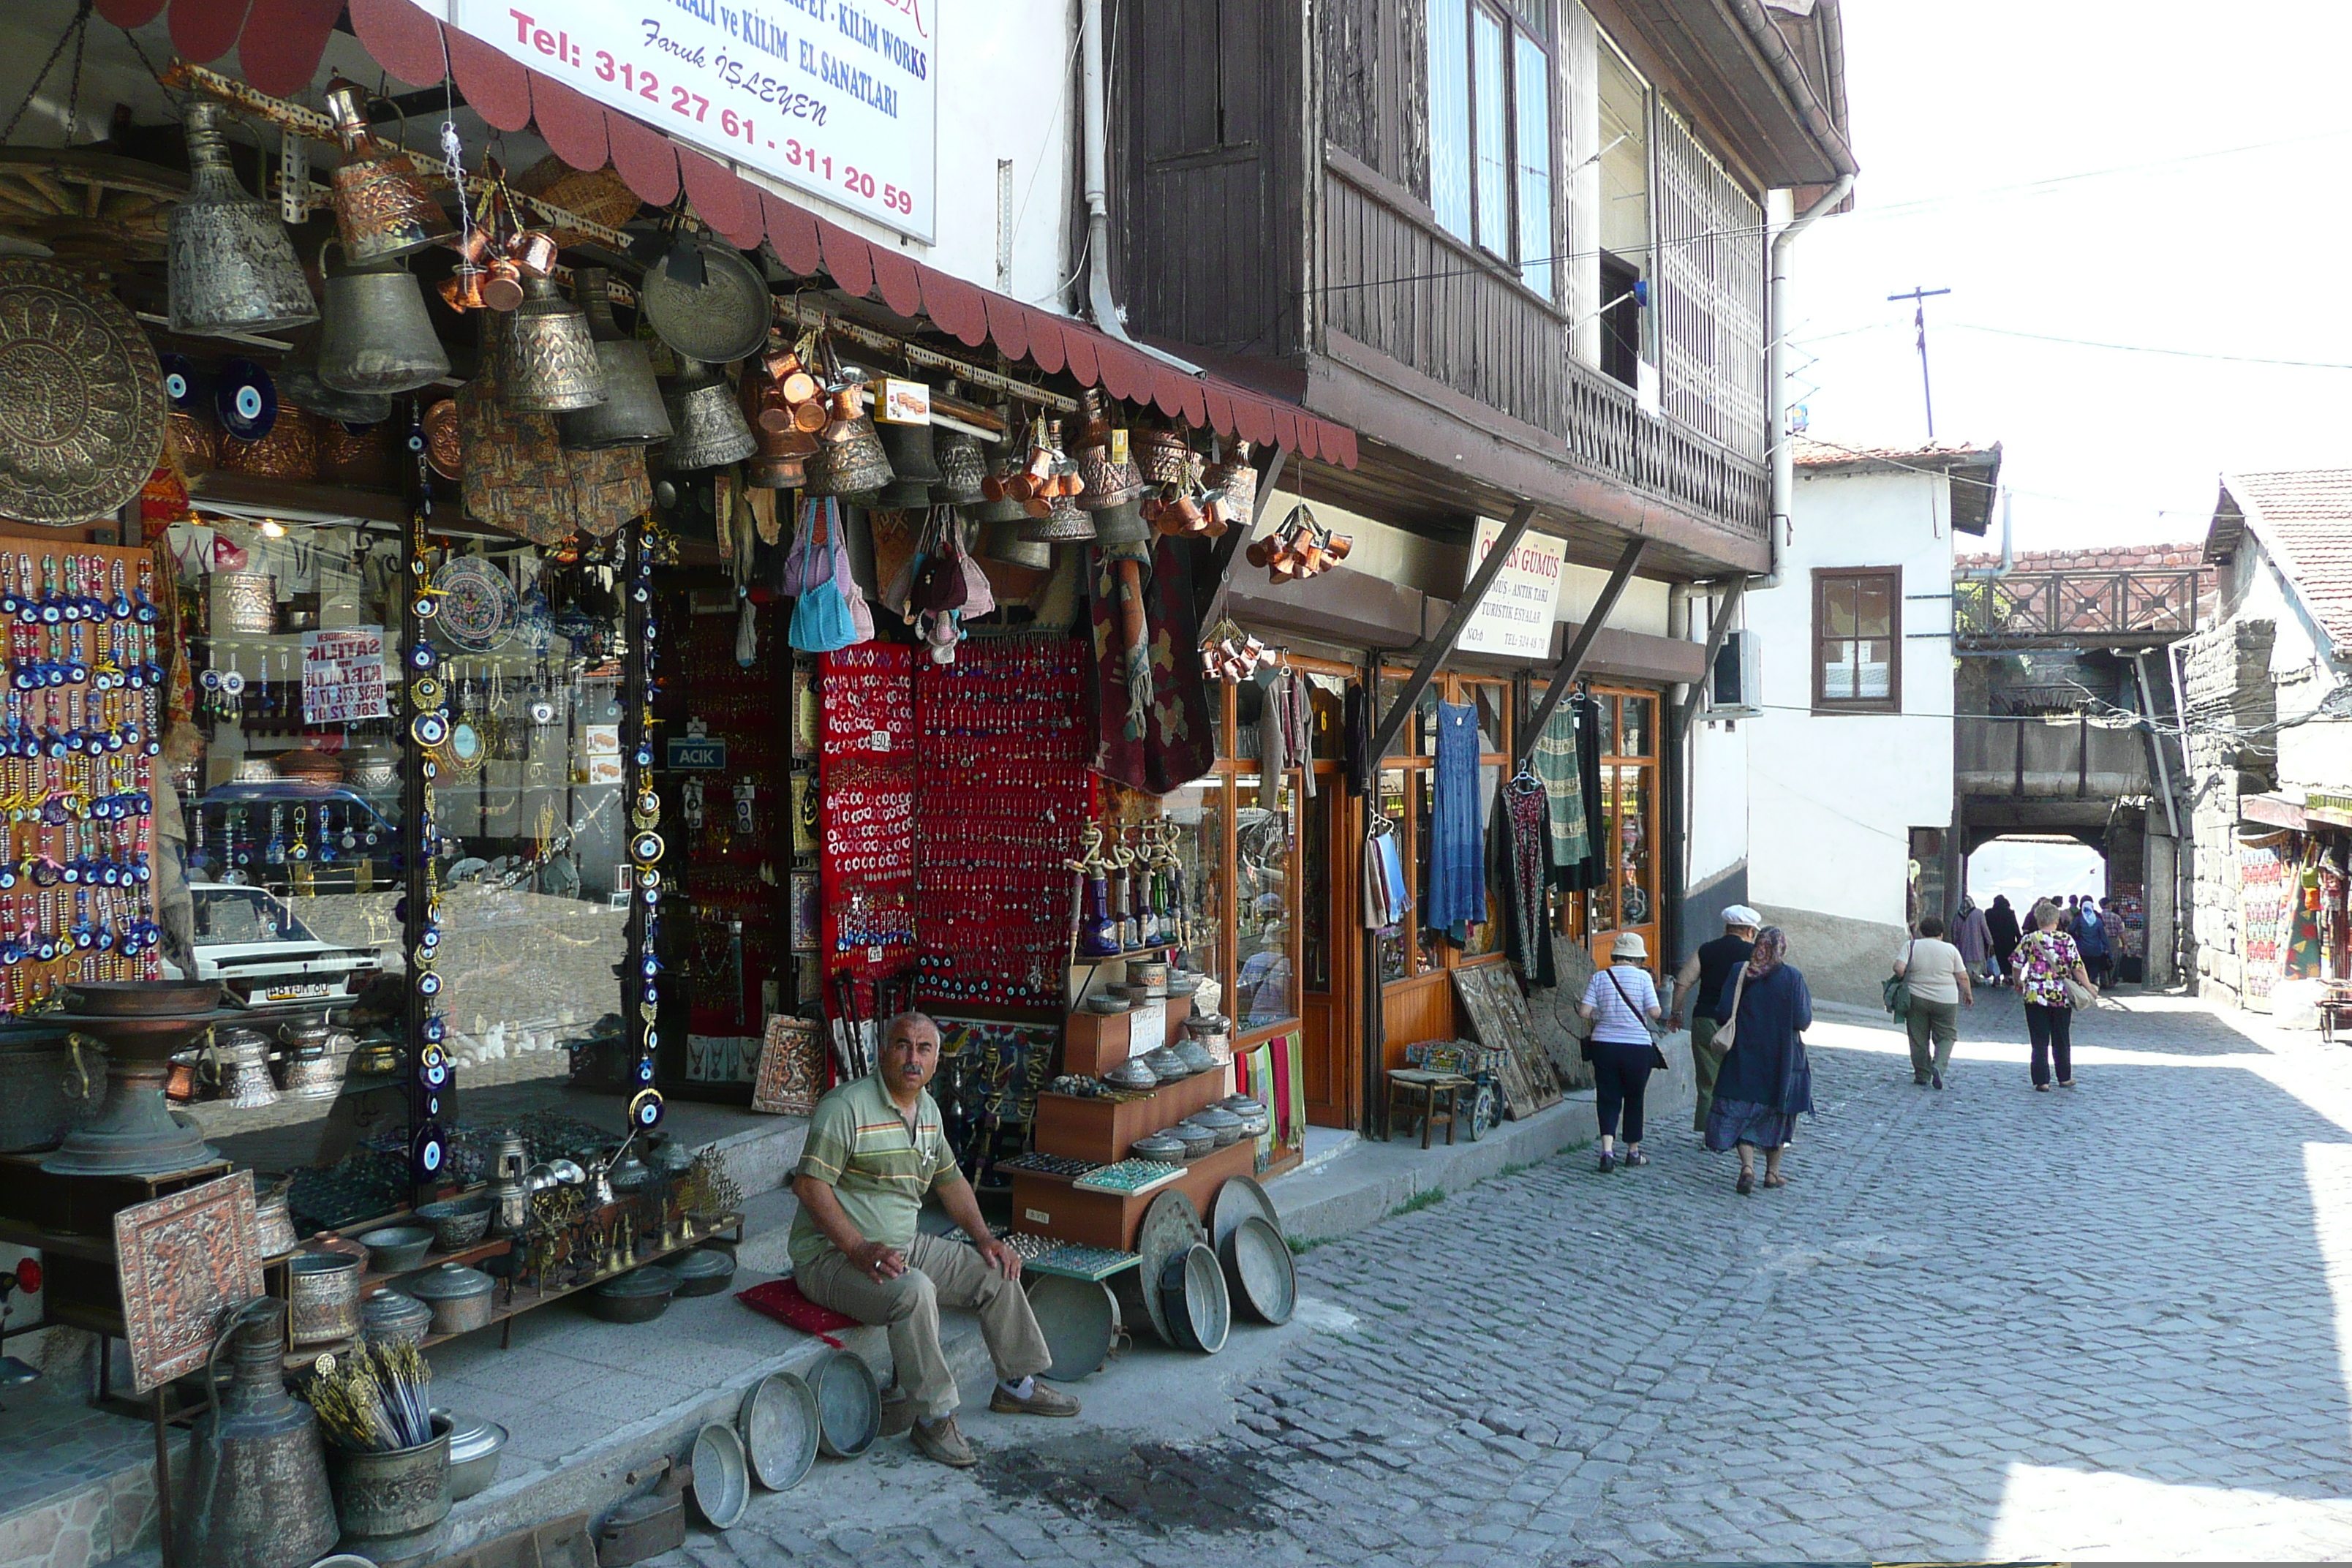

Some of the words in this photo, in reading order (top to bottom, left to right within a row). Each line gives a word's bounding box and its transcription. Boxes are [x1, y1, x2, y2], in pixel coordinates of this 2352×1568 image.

[641, 19, 706, 69] Faruk
[720, 6, 738, 37] ve
[742, 8, 788, 62] KİLİM
[799, 38, 817, 77] EL
[821, 50, 898, 119] SANATLARI
[839, 1, 878, 53] KİLİM
[882, 28, 927, 81] WORKS
[510, 7, 581, 69] Tel:
[595, 50, 659, 104] 312
[671, 86, 709, 123] 27
[721, 109, 753, 145] 61
[786, 139, 832, 181] 311
[845, 166, 875, 198] 20
[883, 184, 912, 215] 59
[1522, 543, 1559, 585] GÜMÜŞ
[1482, 599, 1514, 619] TURİSTİK
[1322, 710, 1327, 731] 6
